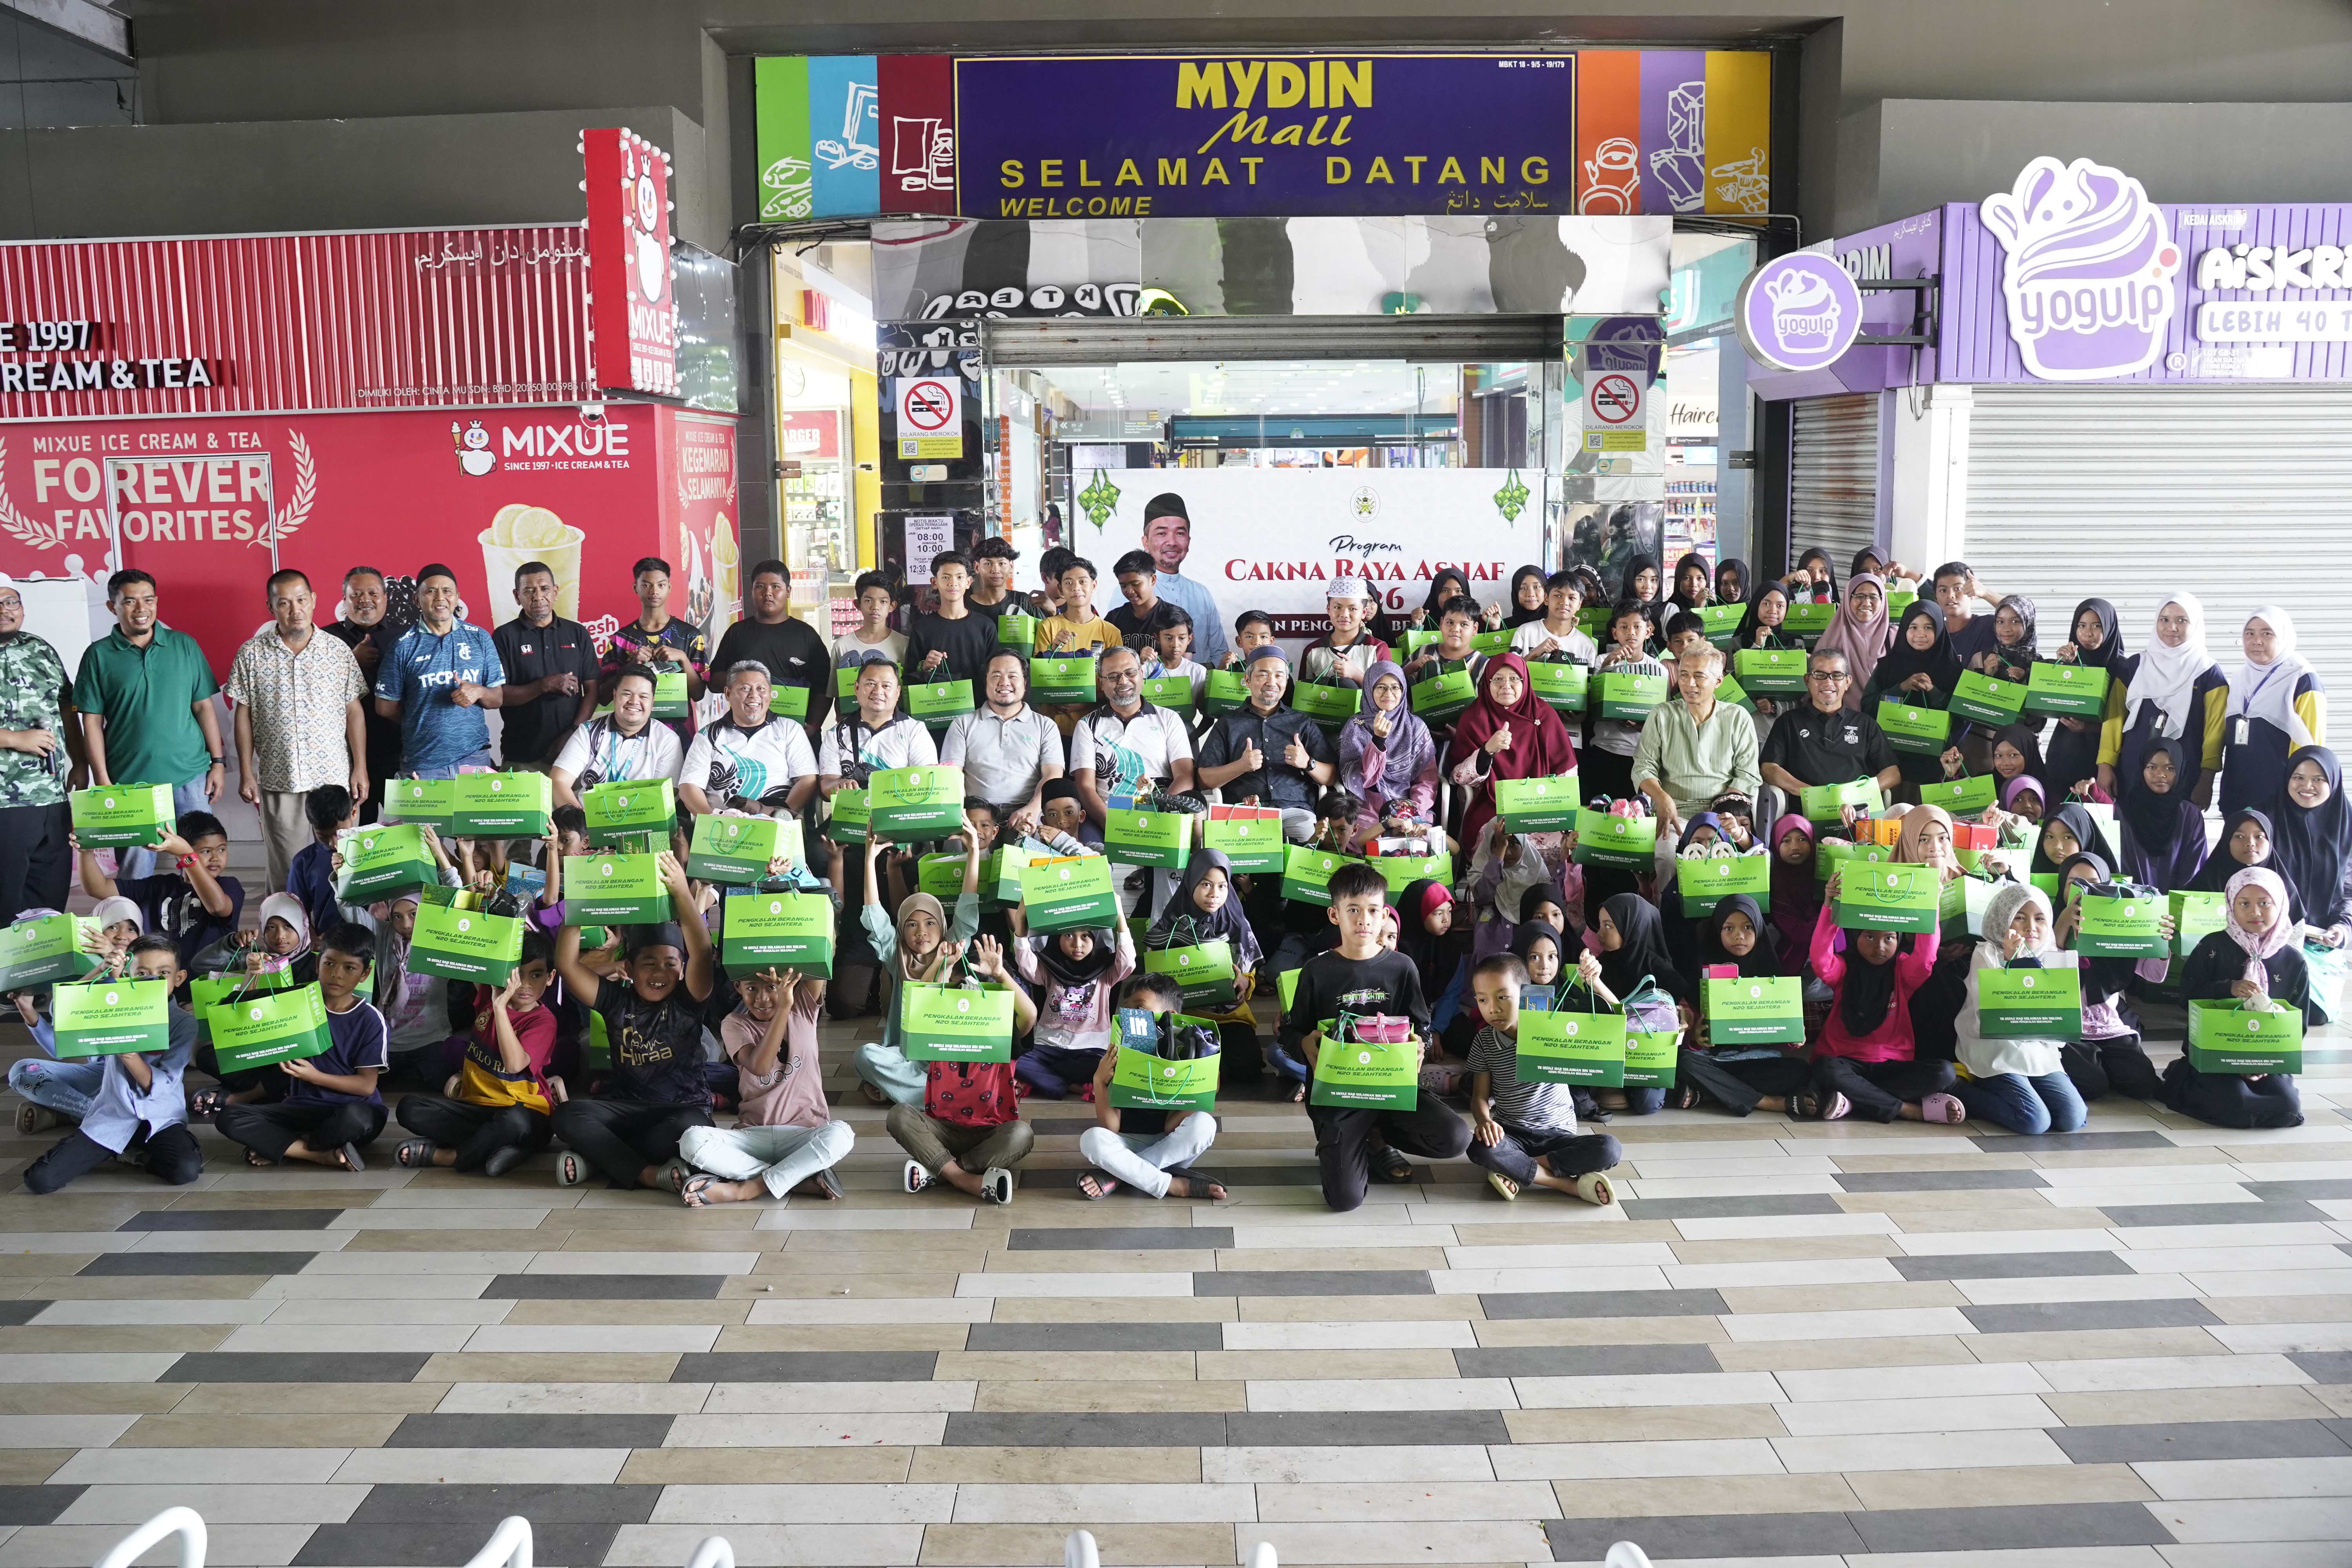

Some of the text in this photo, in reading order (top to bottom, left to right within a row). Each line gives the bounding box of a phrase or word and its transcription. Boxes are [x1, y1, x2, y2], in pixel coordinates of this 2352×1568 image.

[1176, 60, 1372, 109] MYDIN
[1197, 110, 1352, 154] Mall
[1000, 156, 1549, 188] SELAMAT DATANG
[1000, 196, 1152, 217] WELCOME
[1494, 191, 1549, 209] سلامت
[2183, 214, 2244, 225] KEDAI AISKRIM
[2020, 281, 2163, 334] yogulp
[630, 302, 671, 346] MIXUE
[1779, 317, 1833, 335] yogulp
[2208, 310, 2281, 333] LEBIH
[2296, 310, 2327, 332] 40
[26, 320, 89, 351] 1997
[2, 357, 211, 392] REAM & TEA
[358, 388, 391, 397] DIMILIKI
[393, 388, 420, 396] OLEH:
[422, 387, 450, 396] CINTA
[453, 386, 466, 394] MU
[1670, 403, 1719, 426] Hairc
[33, 432, 262, 453] MIXUE ICE CREAM & TEA
[502, 423, 629, 457] MIXUE
[685, 431, 697, 442] MIXUE
[504, 460, 630, 471] SINCE 1997 ICE CREAM & TEA
[682, 446, 729, 473] KEGEMARAN
[33, 457, 270, 504] FOREVER
[688, 477, 727, 501] SELAMANYA
[54, 508, 255, 542] FAVORITES
[1329, 535, 1402, 558] Program
[1225, 558, 1321, 581] CAKNA
[1334, 559, 1407, 581] RAYA
[584, 618, 615, 634] esh
[1342, 993, 1362, 1003] STREET
[467, 1041, 491, 1066] POLO
